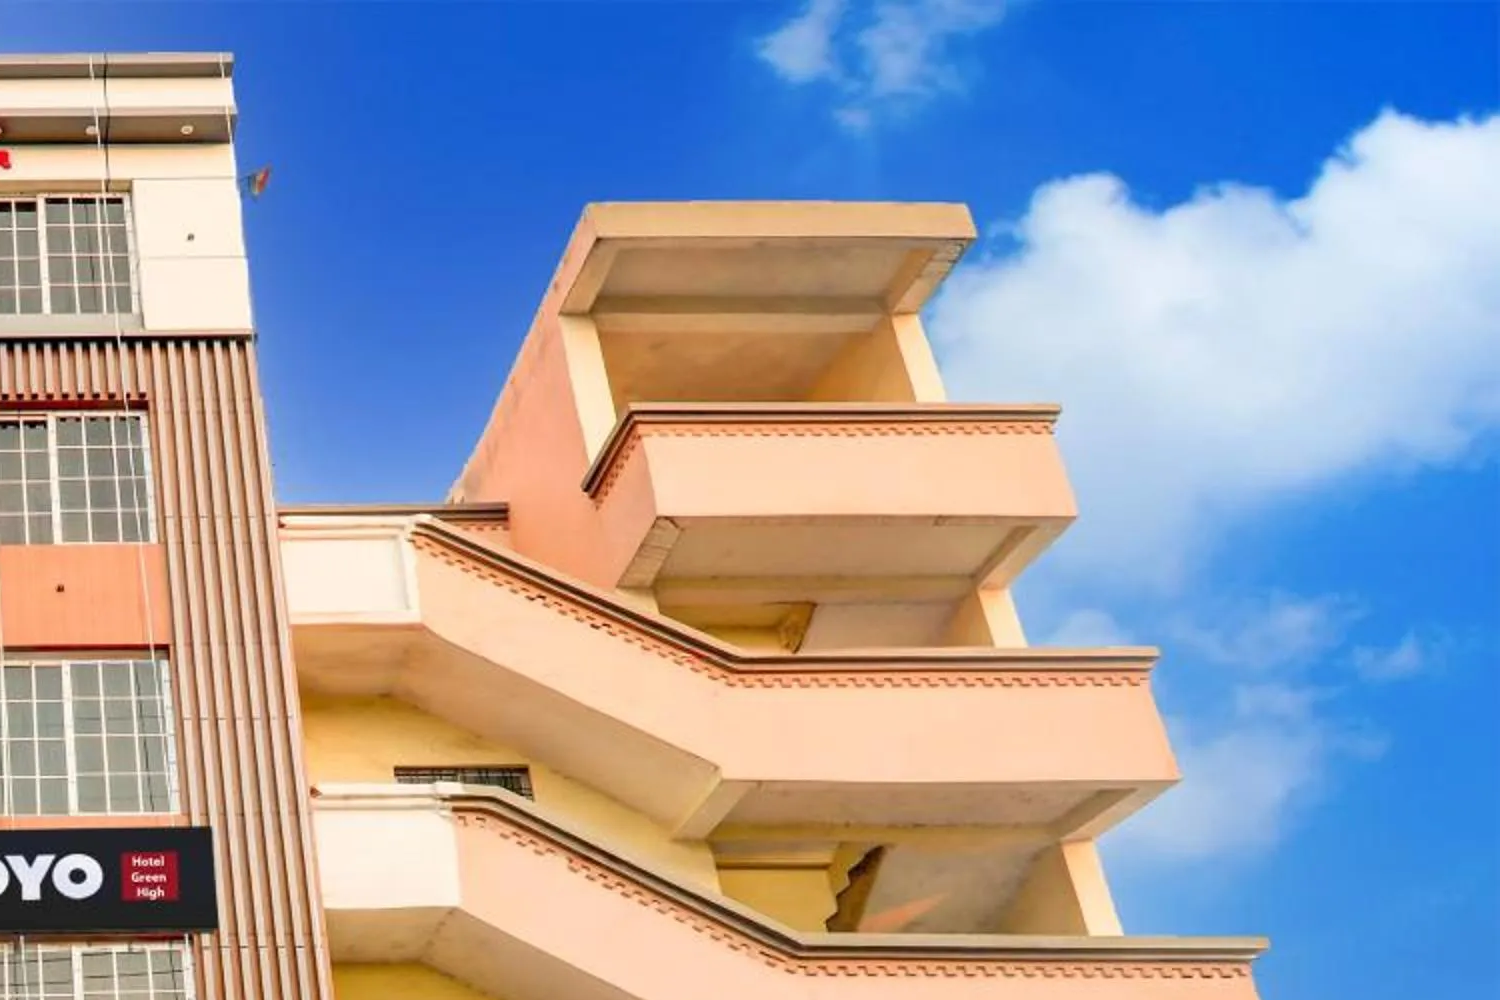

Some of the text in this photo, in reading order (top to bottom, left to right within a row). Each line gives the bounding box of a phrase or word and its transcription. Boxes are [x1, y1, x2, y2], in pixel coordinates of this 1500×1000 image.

[132, 855, 165, 867] Hotel
[131, 871, 167, 883] Green
[136, 886, 165, 899] High
